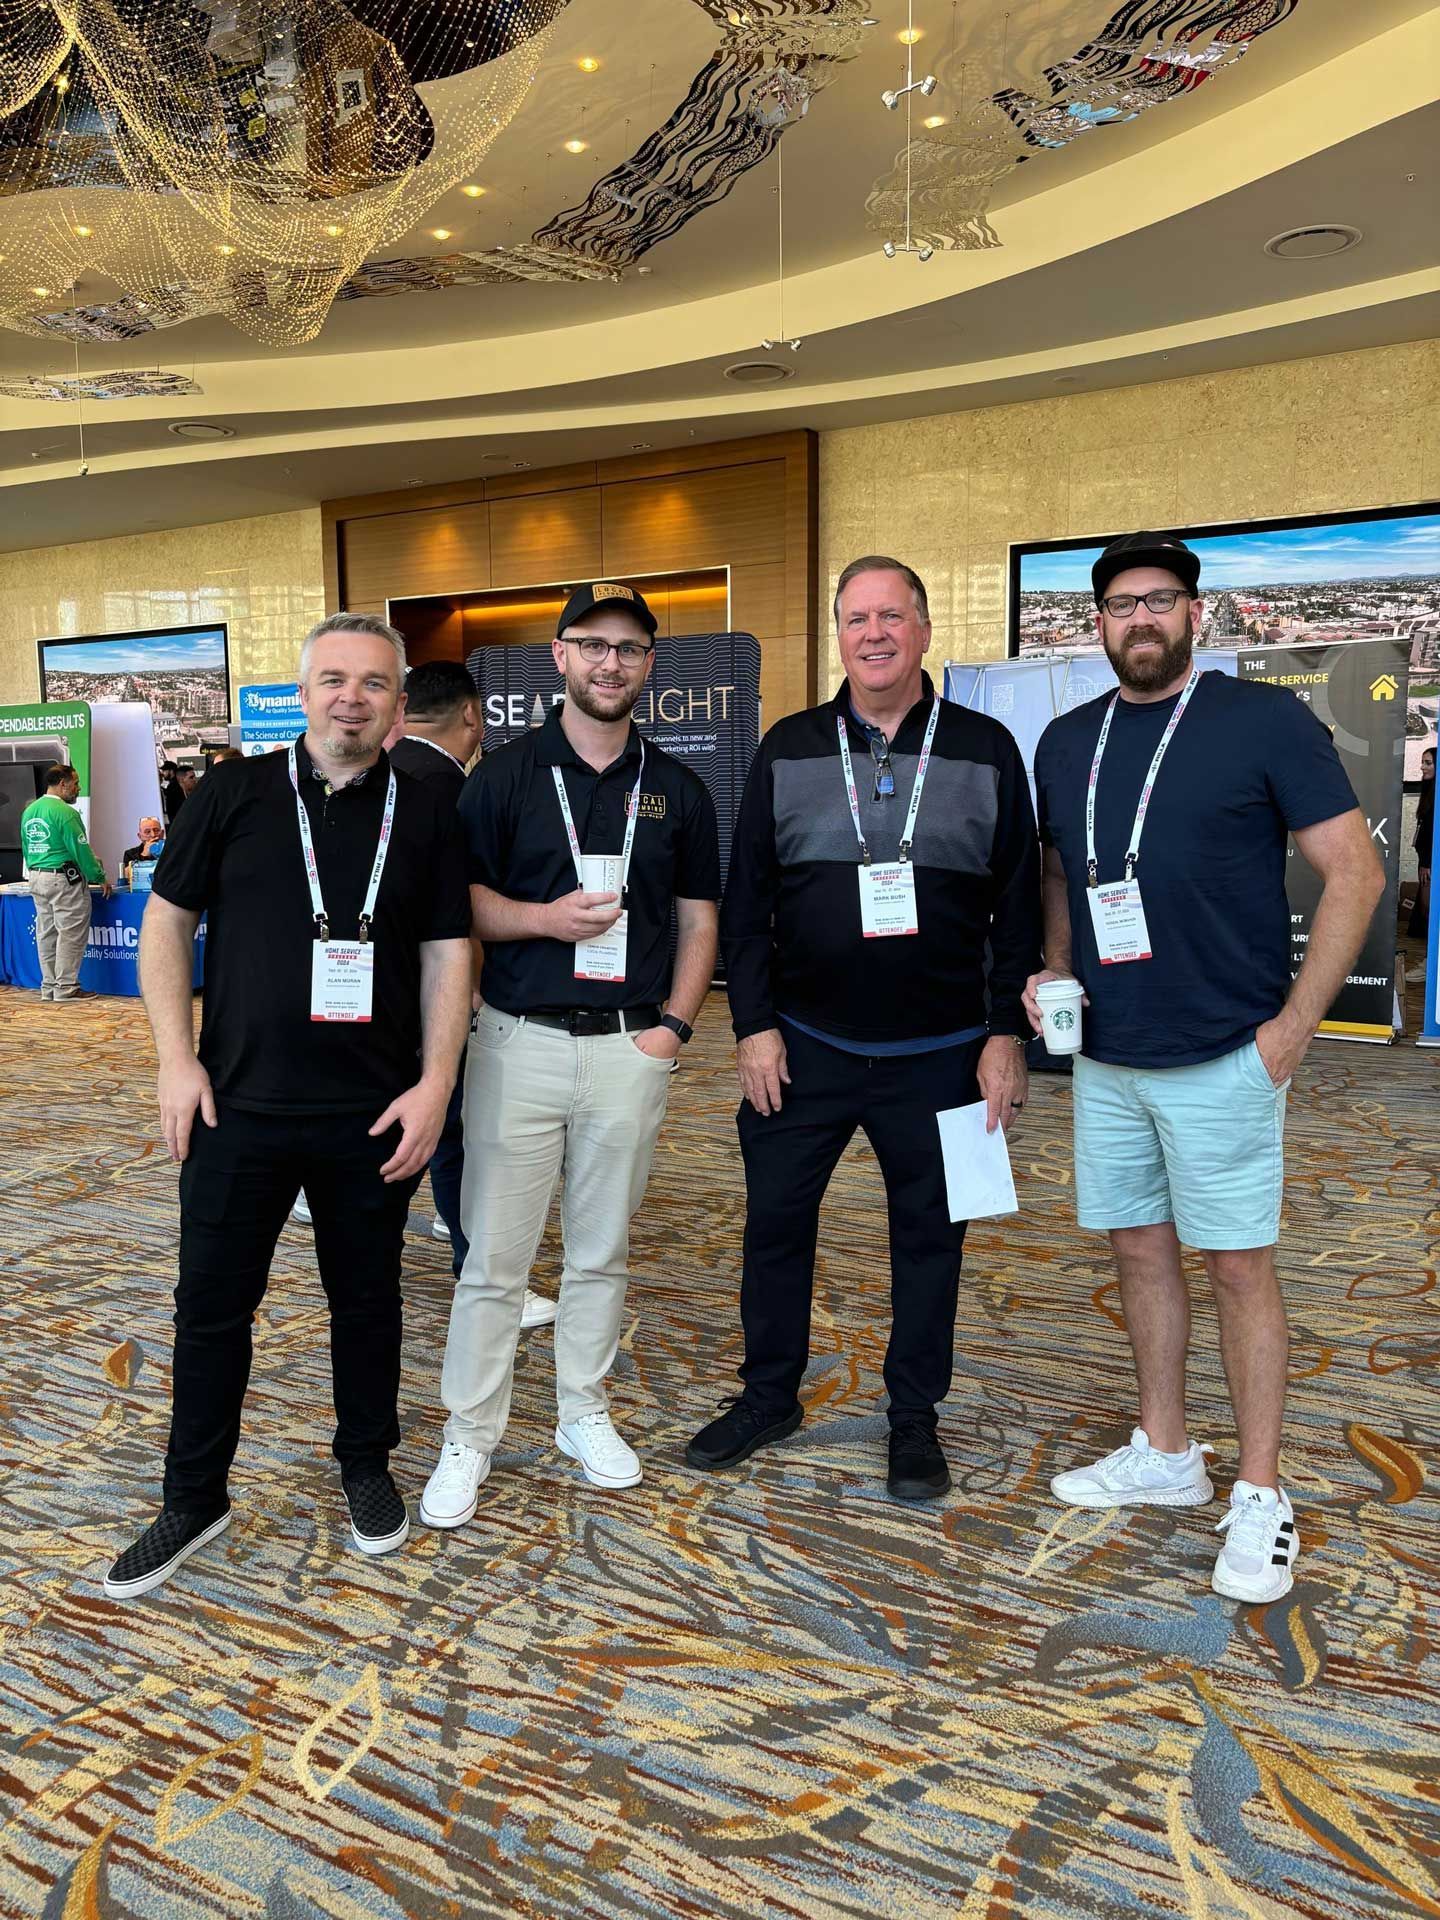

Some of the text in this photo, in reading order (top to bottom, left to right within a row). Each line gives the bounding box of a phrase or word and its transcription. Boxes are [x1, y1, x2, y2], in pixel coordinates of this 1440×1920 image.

[1244, 660, 1266, 671] THE
[1279, 673, 1329, 685] SERVICE
[247, 691, 302, 711] Dynami
[0, 713, 85, 733] PENDABLE RESULTS
[243, 730, 300, 740] The Science of Clea
[652, 735, 681, 743] channels
[704, 733, 717, 741] and
[689, 744, 701, 752] ROI
[701, 744, 716, 752] with
[627, 795, 663, 806] LCAL
[1110, 887, 1129, 897] SERVICE
[83, 948, 139, 961] ality Solutions
[340, 947, 362, 955] SERVICE
[1345, 975, 1388, 987] GEMENT
